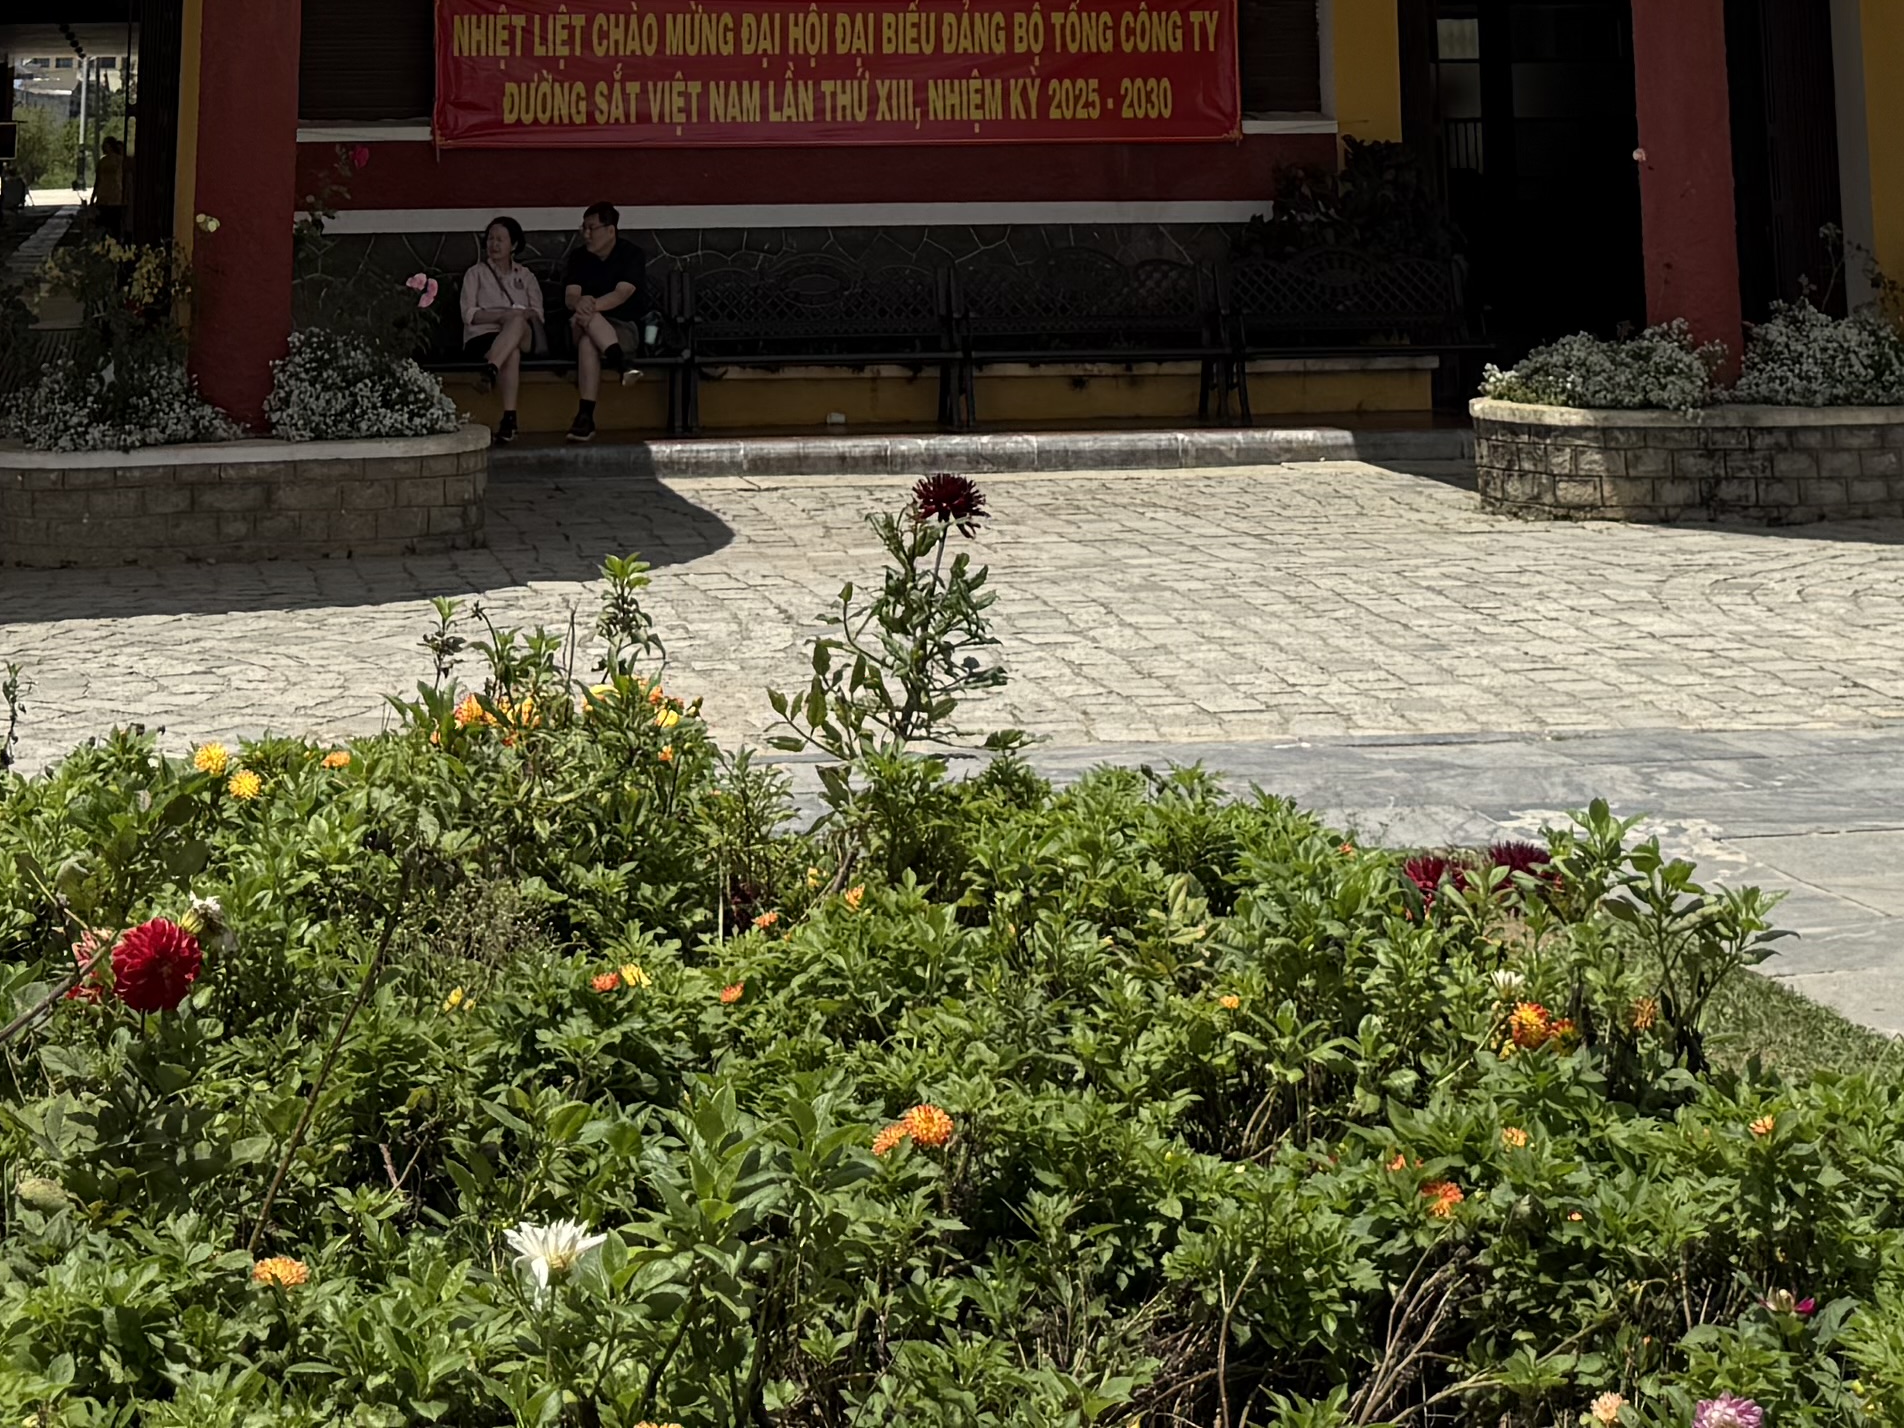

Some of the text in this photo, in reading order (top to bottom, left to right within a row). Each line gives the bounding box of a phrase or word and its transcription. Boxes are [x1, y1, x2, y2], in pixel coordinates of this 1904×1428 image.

[453, 5, 527, 70] NHIỆT
[534, 4, 587, 70] LIỆT
[592, 2, 658, 56] CHÀO
[665, 1, 734, 56] MỪNG
[741, 12, 781, 68] ĐẠI
[789, 2, 829, 68] HỘI
[835, 11, 874, 67] ĐẠI
[1013, 1, 1045, 66] BỘ
[1120, 1, 1184, 54] CÔNG
[1189, 11, 1220, 53] TY
[502, 70, 587, 125] ĐƯỜNG
[594, 62, 641, 124] SẮT
[647, 71, 703, 136] VIỆT
[709, 80, 761, 123] NAM
[768, 61, 815, 122] LẦN
[821, 66, 870, 122] THỨ
[874, 78, 922, 130] XIII,
[928, 68, 1004, 133] NHIỆM
[1009, 65, 1041, 121] KỲ
[1048, 77, 1101, 120] 2025
[1120, 77, 1173, 119] 2030
